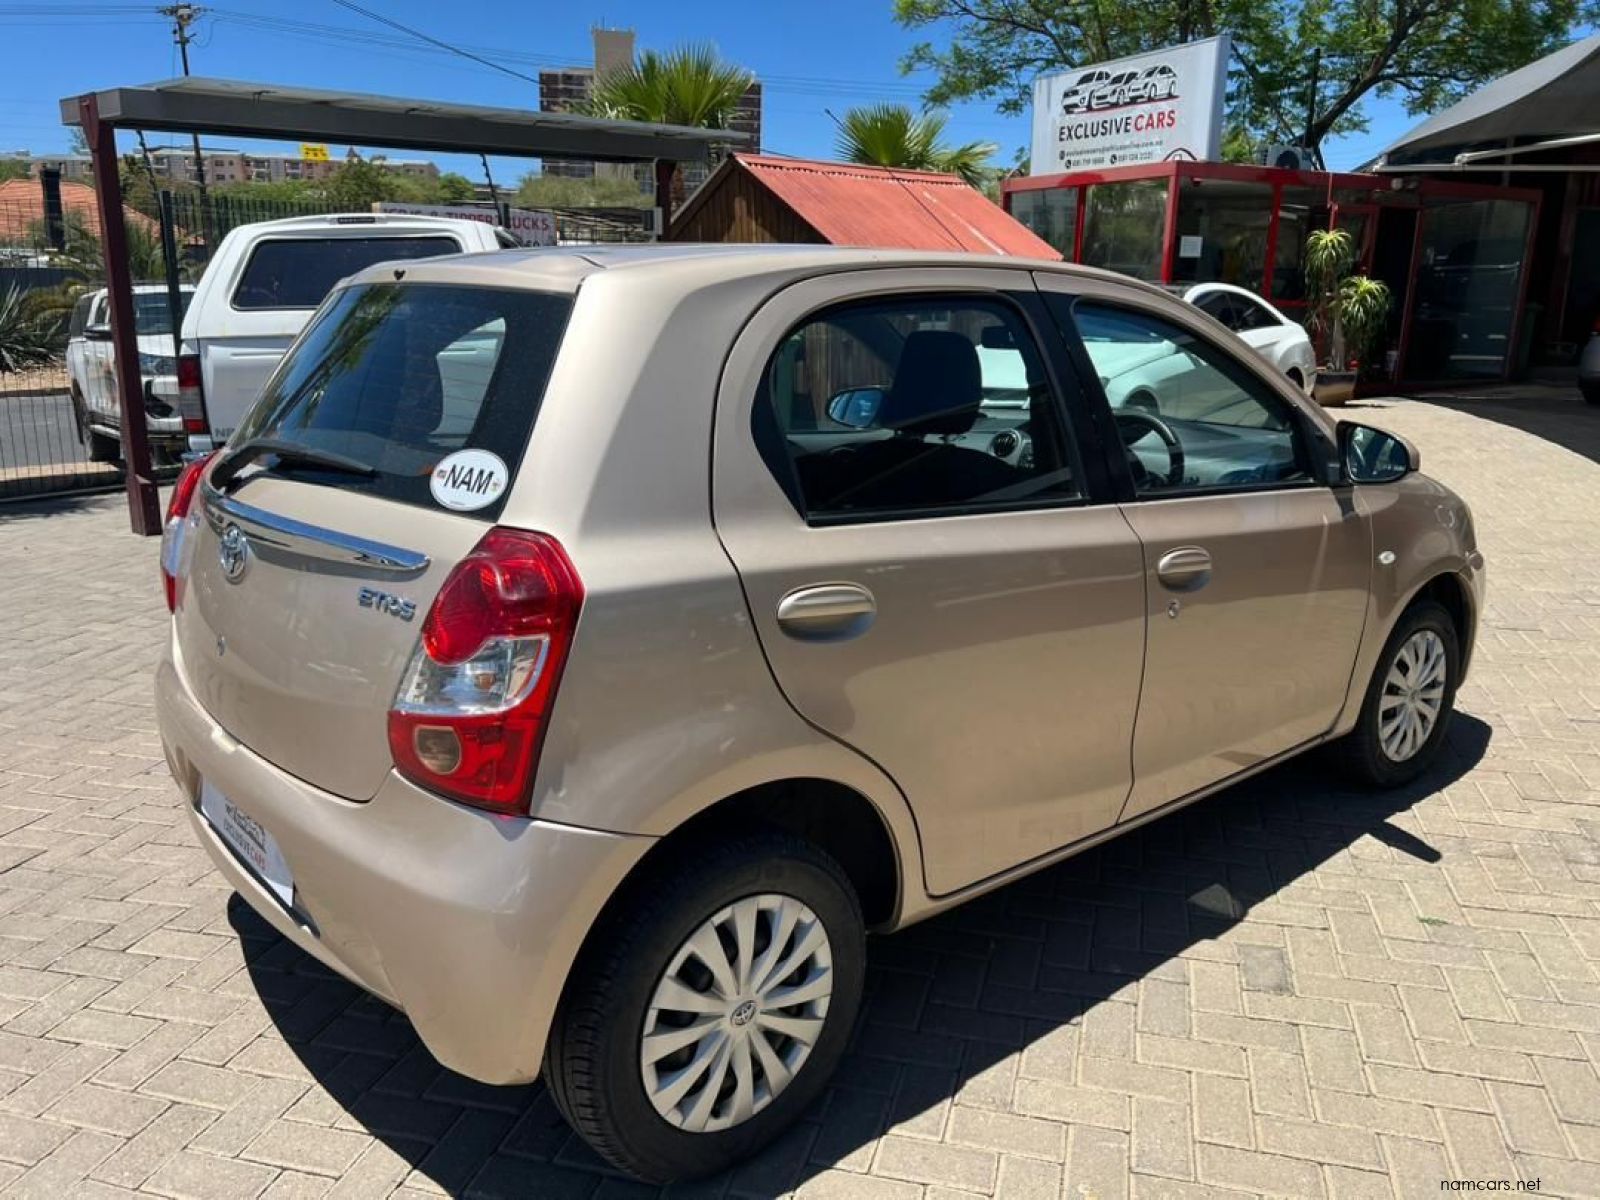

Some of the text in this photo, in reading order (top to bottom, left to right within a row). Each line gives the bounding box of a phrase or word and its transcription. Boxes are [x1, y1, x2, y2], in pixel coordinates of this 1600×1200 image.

[1058, 109, 1176, 142] EXCLUSIVE CARS
[443, 464, 494, 496] NAM
